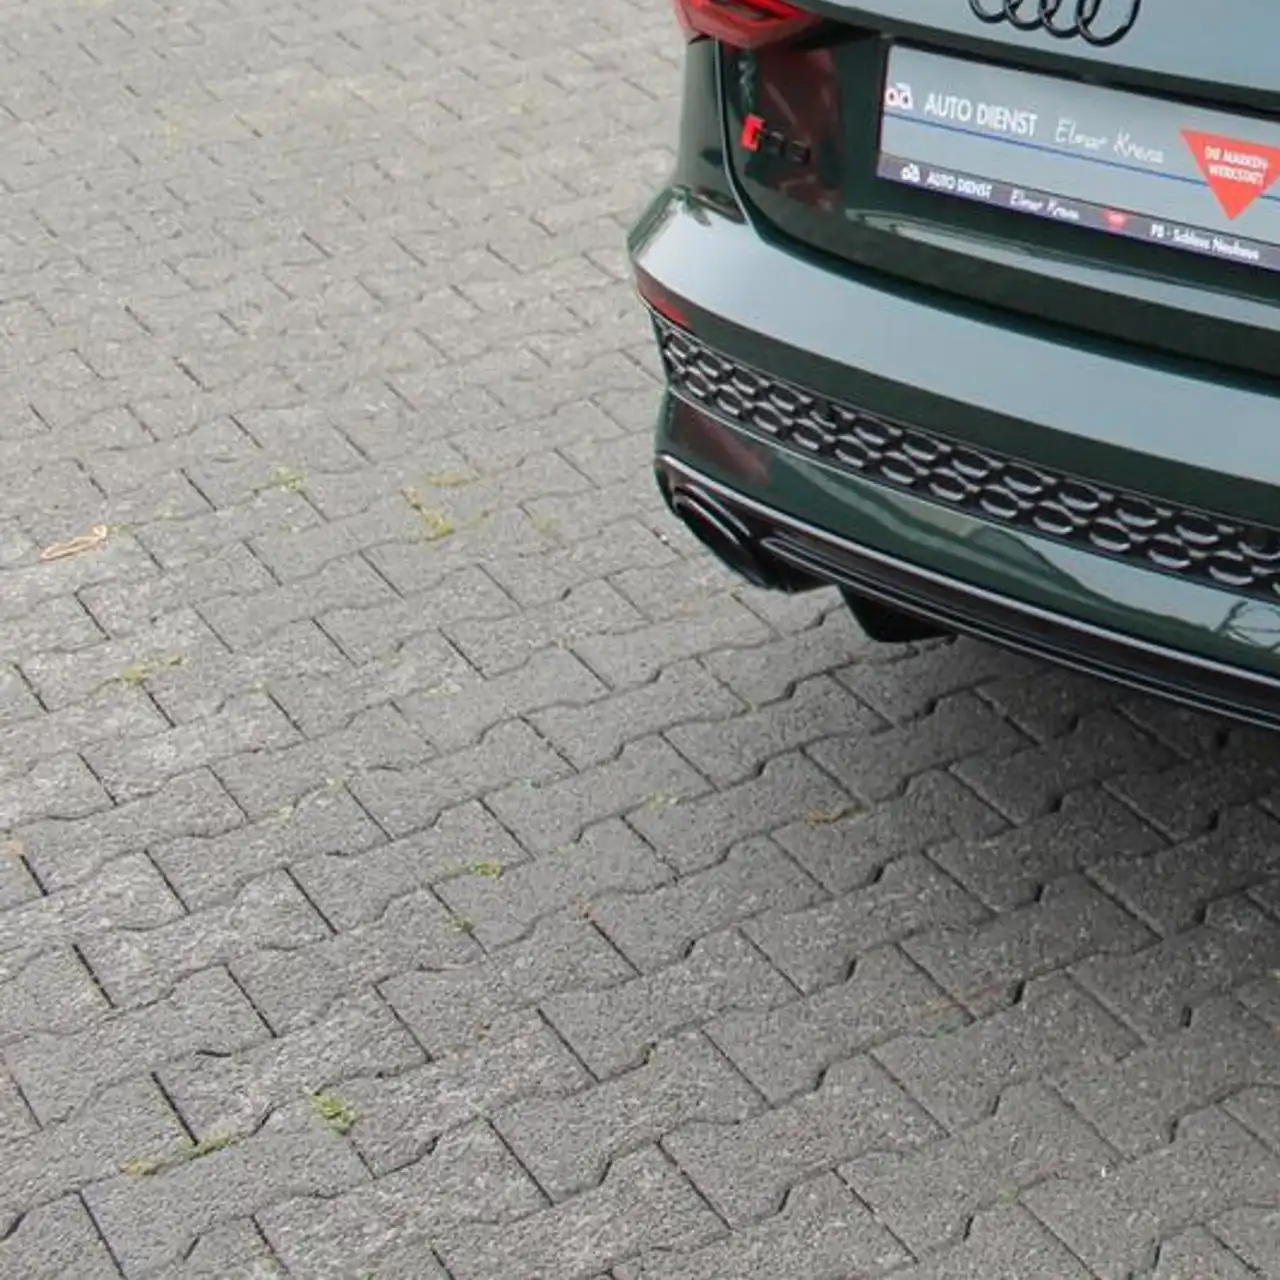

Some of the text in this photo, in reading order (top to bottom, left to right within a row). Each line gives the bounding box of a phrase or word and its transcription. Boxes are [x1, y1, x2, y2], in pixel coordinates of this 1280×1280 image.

[923, 93, 972, 121] AUTO
[976, 102, 1038, 137] DIENST
[926, 171, 955, 189] AUTO
[957, 177, 993, 200] DIENST
